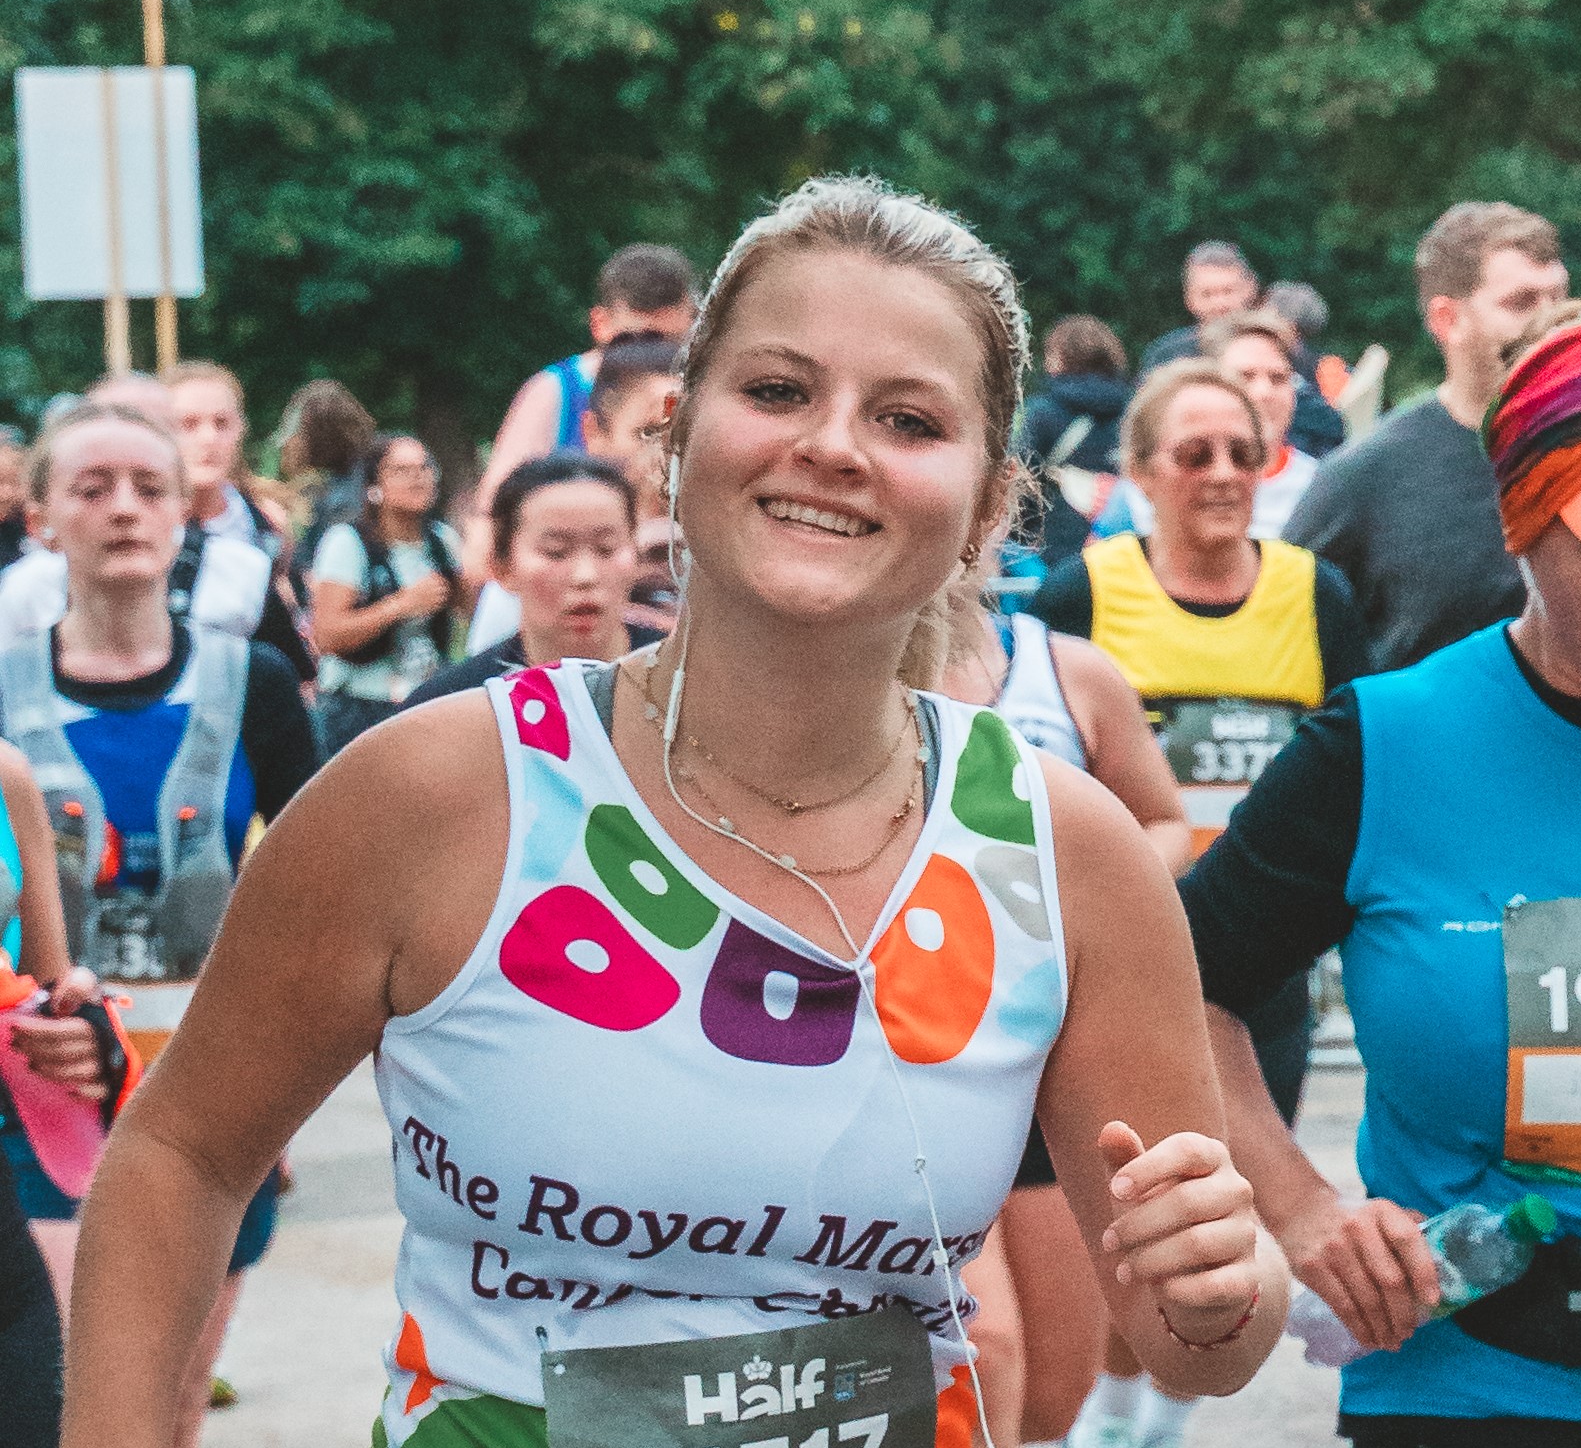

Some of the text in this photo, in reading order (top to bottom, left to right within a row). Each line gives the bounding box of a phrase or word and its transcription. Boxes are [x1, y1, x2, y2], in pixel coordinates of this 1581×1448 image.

[1192, 741, 1284, 781] 337
[403, 1115, 500, 1220] The
[517, 1174, 787, 1259] Royal
[684, 1358, 826, 1425] Half
